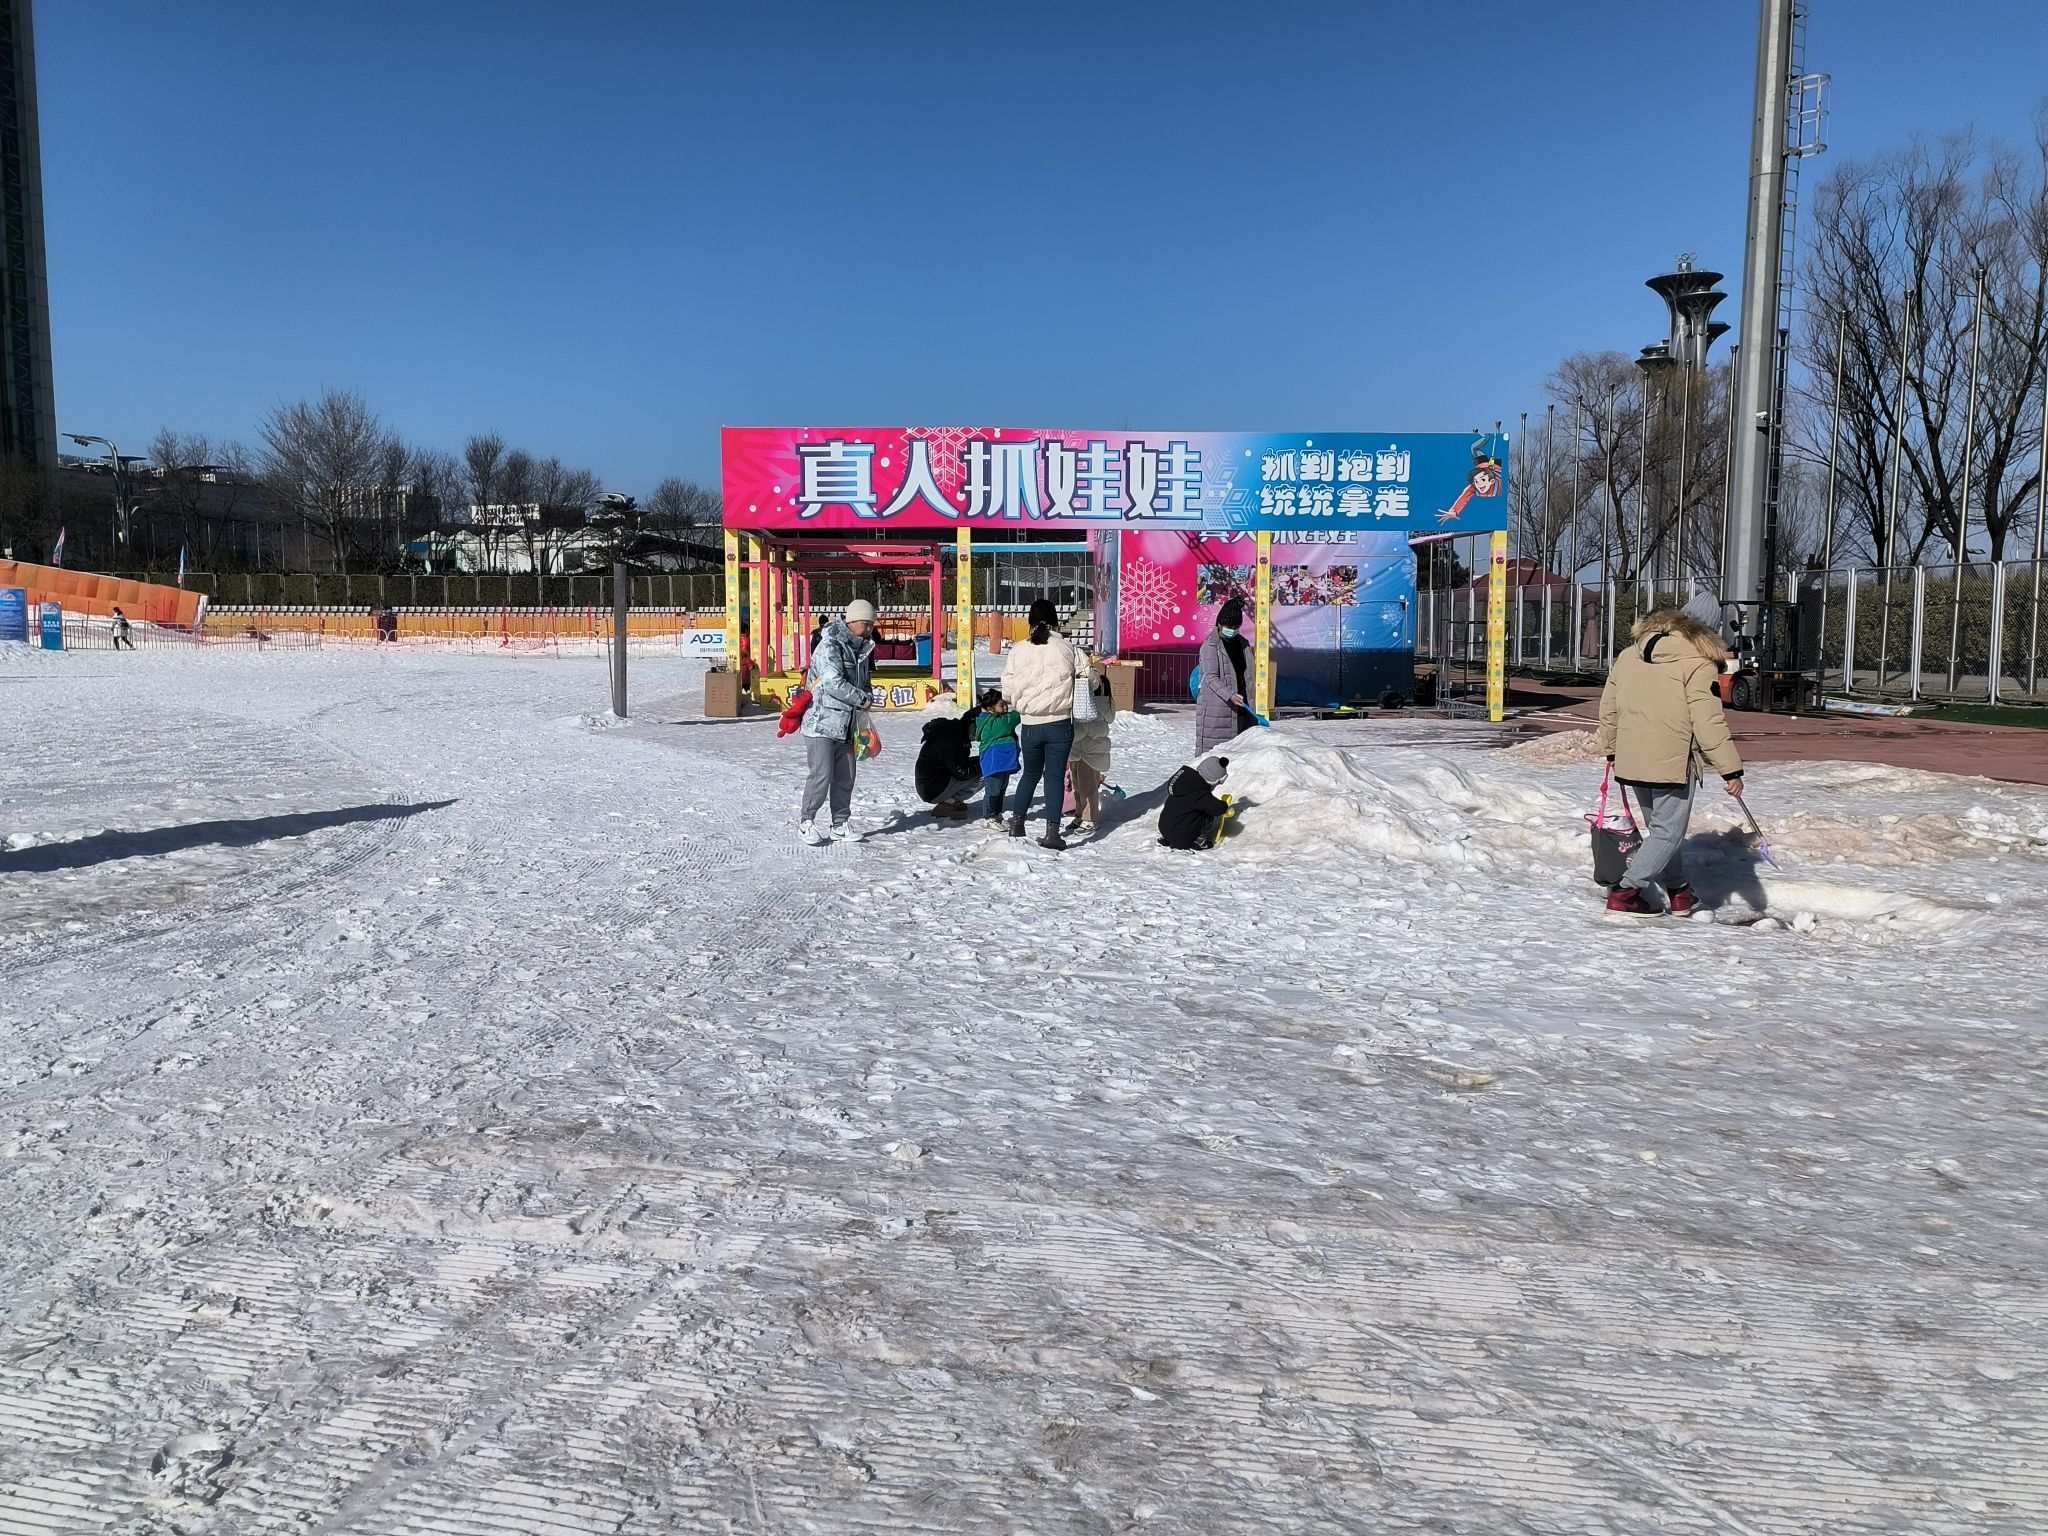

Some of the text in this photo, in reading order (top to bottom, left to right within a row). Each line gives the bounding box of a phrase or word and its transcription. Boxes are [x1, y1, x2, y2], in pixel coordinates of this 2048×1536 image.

[796, 439, 1204, 520] 真人抓娃娃
[1260, 448, 1411, 482] 抓到抱到
[1259, 484, 1411, 518] 统统拿走
